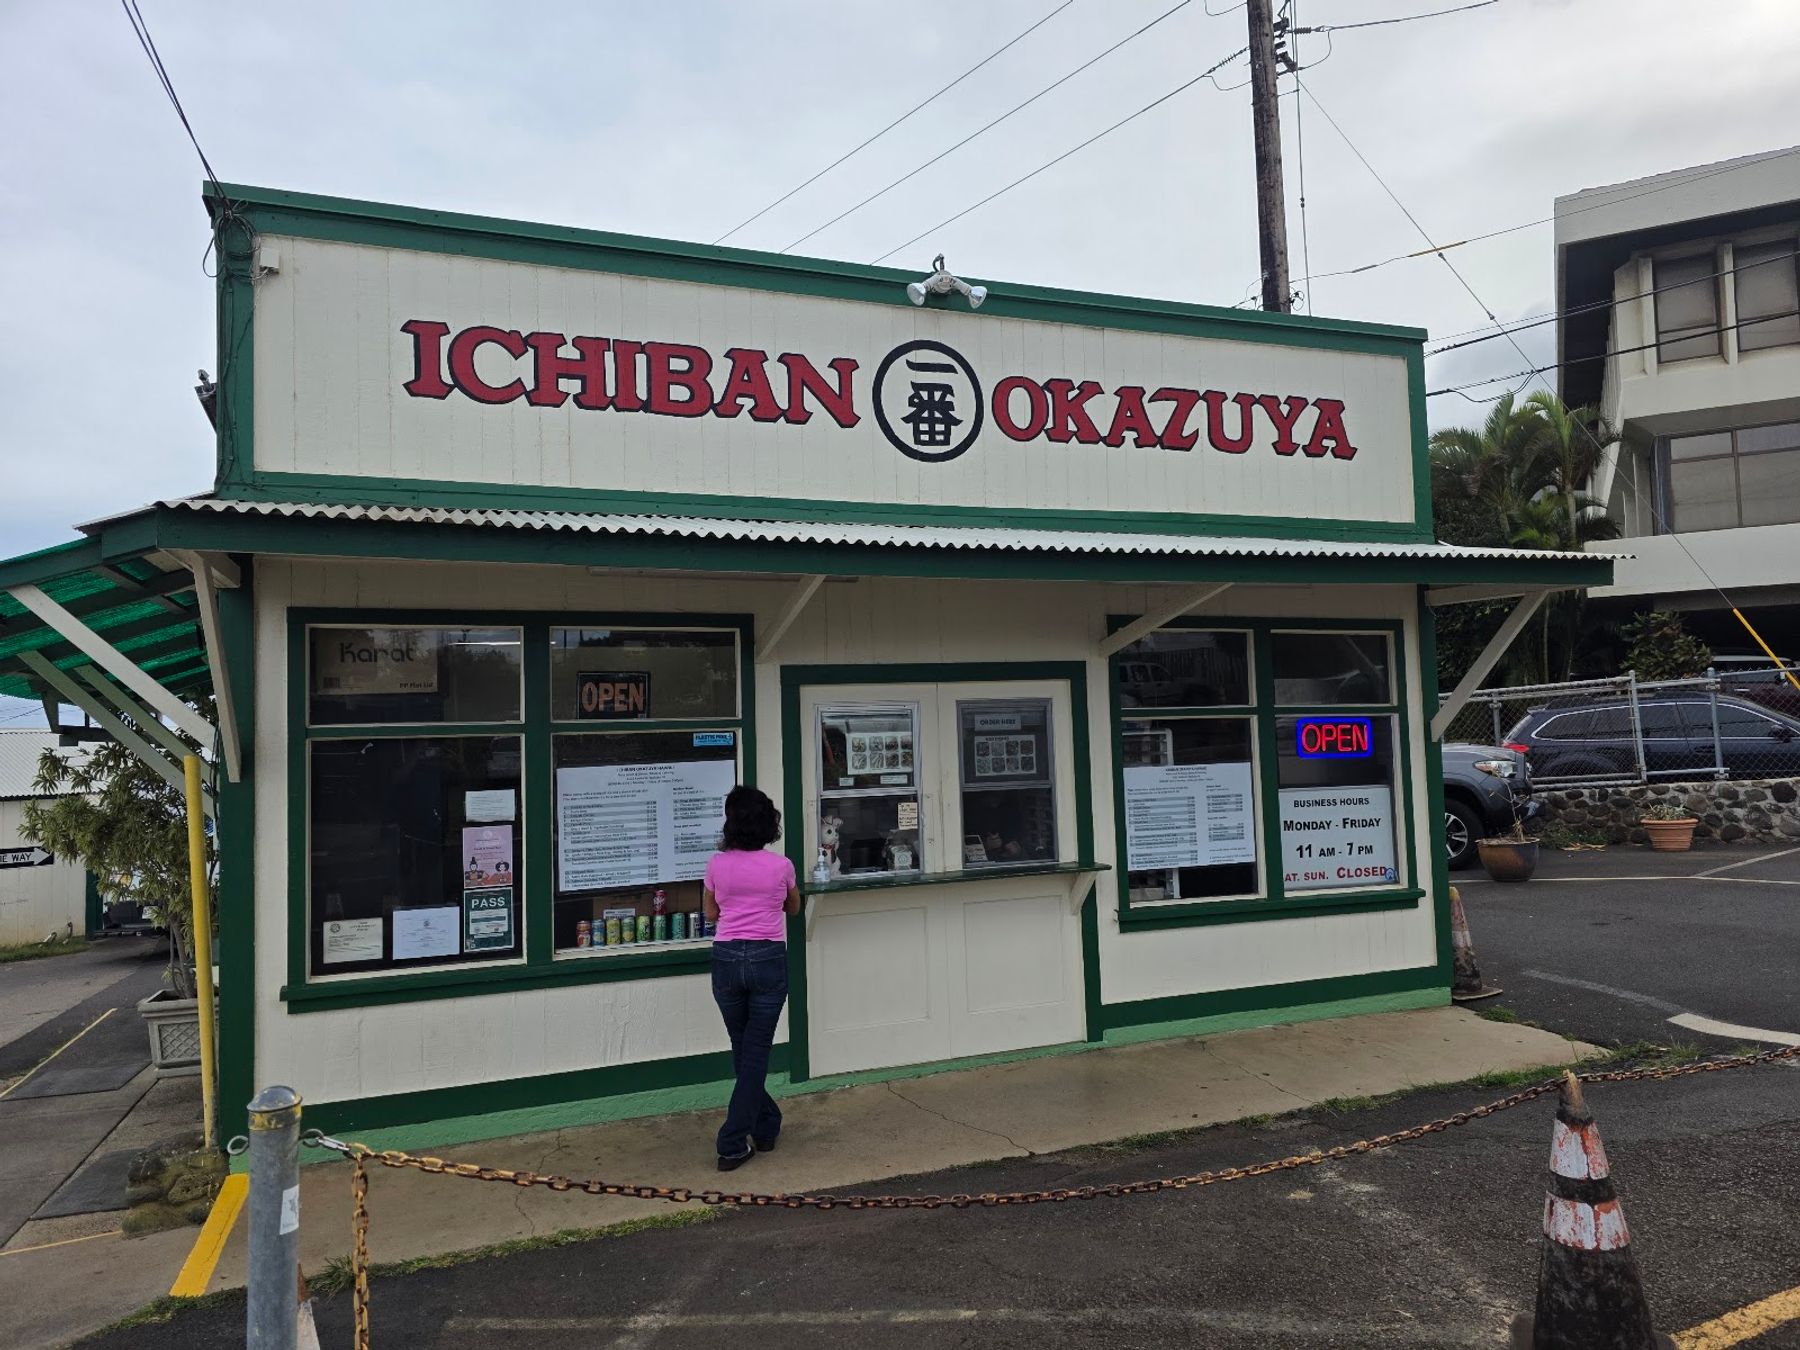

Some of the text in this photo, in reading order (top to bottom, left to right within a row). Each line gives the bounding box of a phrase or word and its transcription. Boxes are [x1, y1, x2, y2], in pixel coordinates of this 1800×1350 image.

[400, 319, 1358, 461] ICHIBAN OKAZUYA
[900, 358, 963, 446] 一番
[339, 641, 414, 663] Karat
[581, 681, 644, 713] OPEN
[979, 717, 1017, 726] ORDER HERE
[1301, 723, 1368, 753] OPEN
[1293, 797, 1370, 808] BUSINESS HOURS
[1283, 819, 1332, 832] MONDAY
[1342, 817, 1381, 829] FRIDAY
[11, 852, 32, 862] WAY
[1295, 843, 1312, 858] 11
[1318, 847, 1336, 858] AM
[1346, 842, 1354, 856] 7
[1357, 844, 1374, 855] PM
[1284, 866, 1387, 882] AT. SUN. CLOSED
[471, 897, 506, 909] PASS
